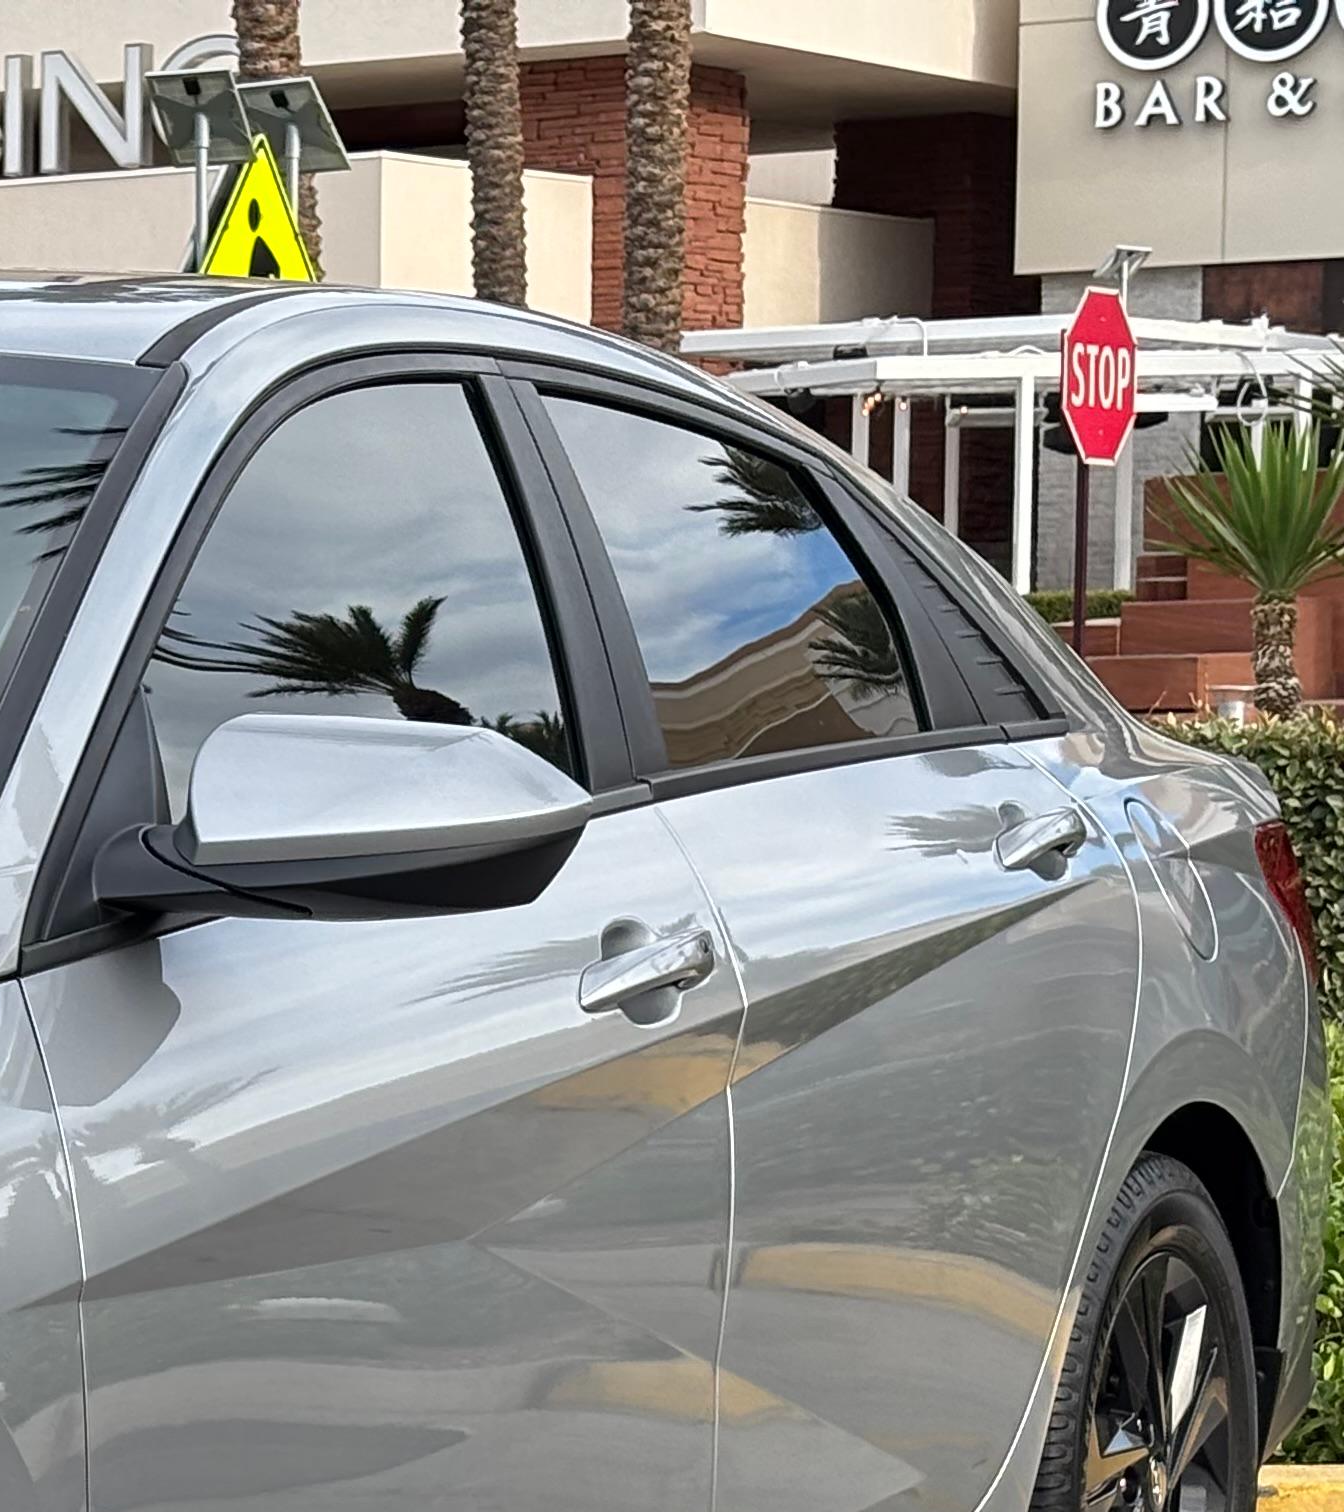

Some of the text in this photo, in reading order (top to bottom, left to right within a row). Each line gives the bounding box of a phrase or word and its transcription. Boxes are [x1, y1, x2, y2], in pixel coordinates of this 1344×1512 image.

[1095, 72, 1315, 128] BAR &
[1072, 342, 1131, 411] STOP
